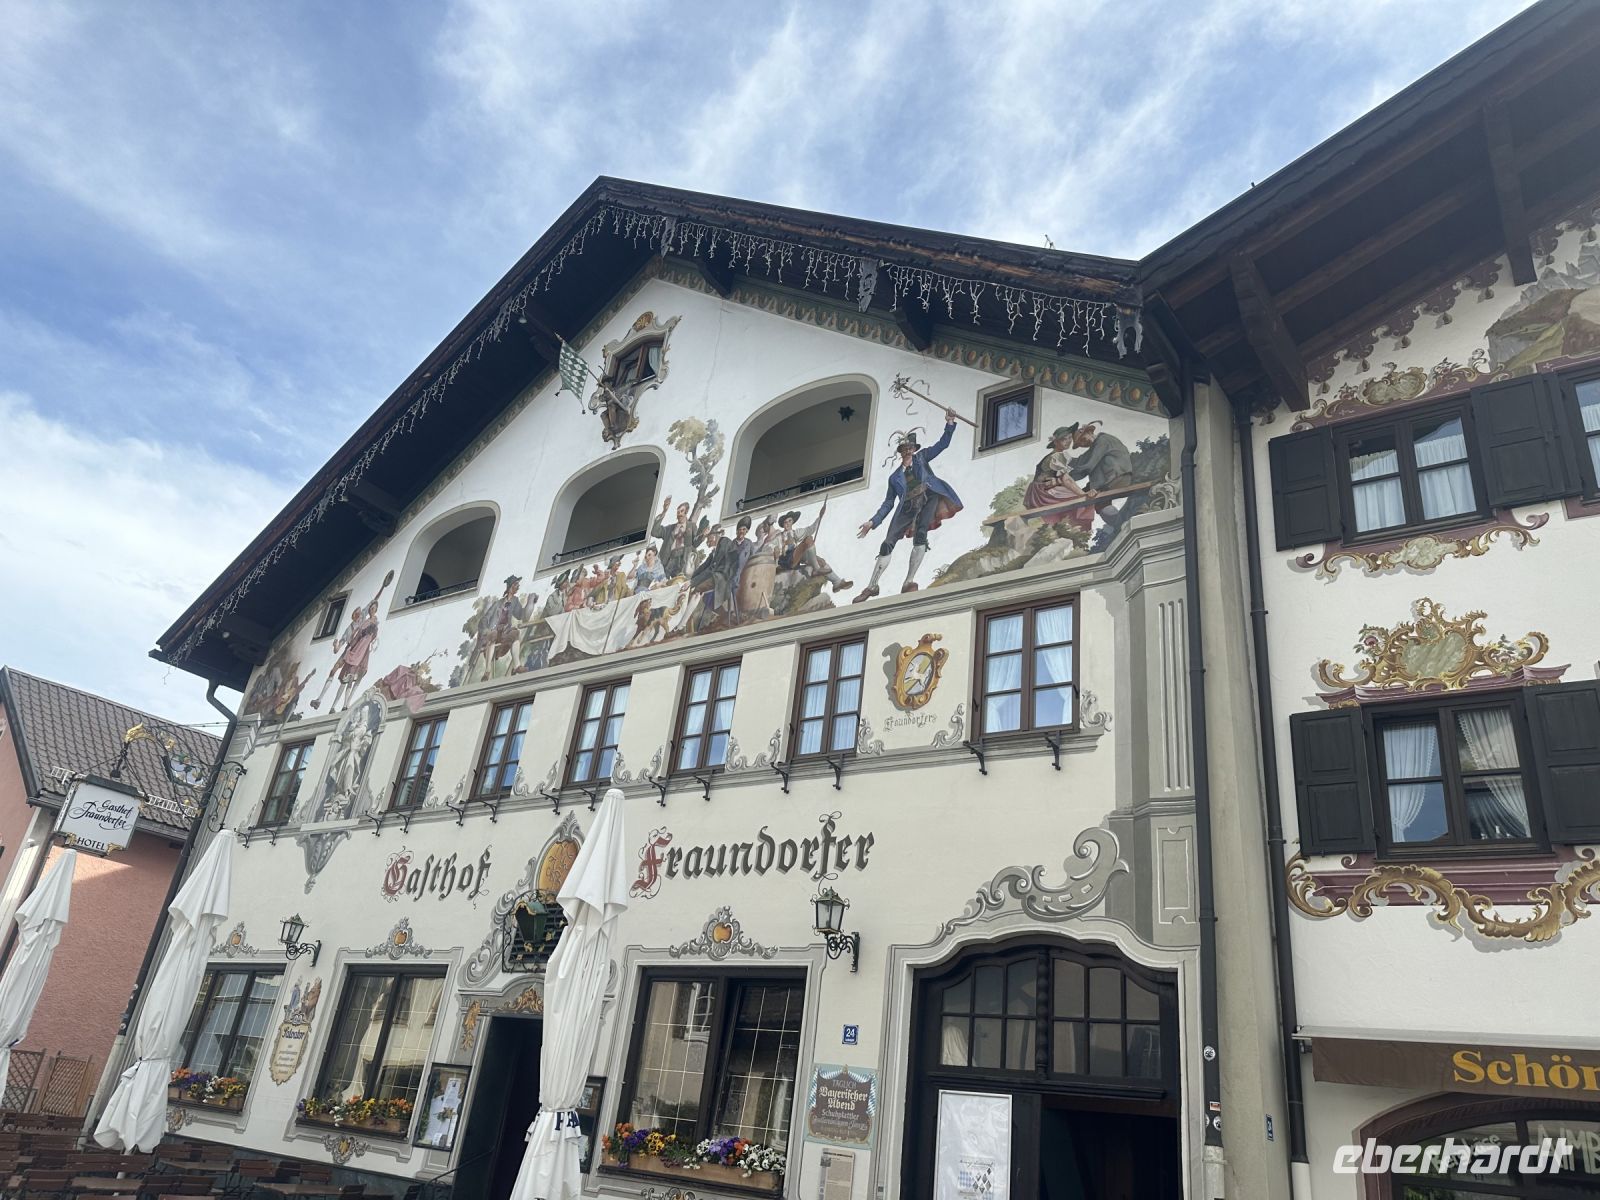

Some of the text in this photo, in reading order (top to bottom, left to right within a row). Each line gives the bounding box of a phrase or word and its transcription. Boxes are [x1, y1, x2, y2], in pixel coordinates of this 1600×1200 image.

[97, 800, 134, 818] Gasthof
[77, 837, 105, 850] HOTEL
[381, 811, 875, 910] Gasthof Fraundorfer
[845, 1028, 855, 1038] 24
[827, 1098, 856, 1111] Abend
